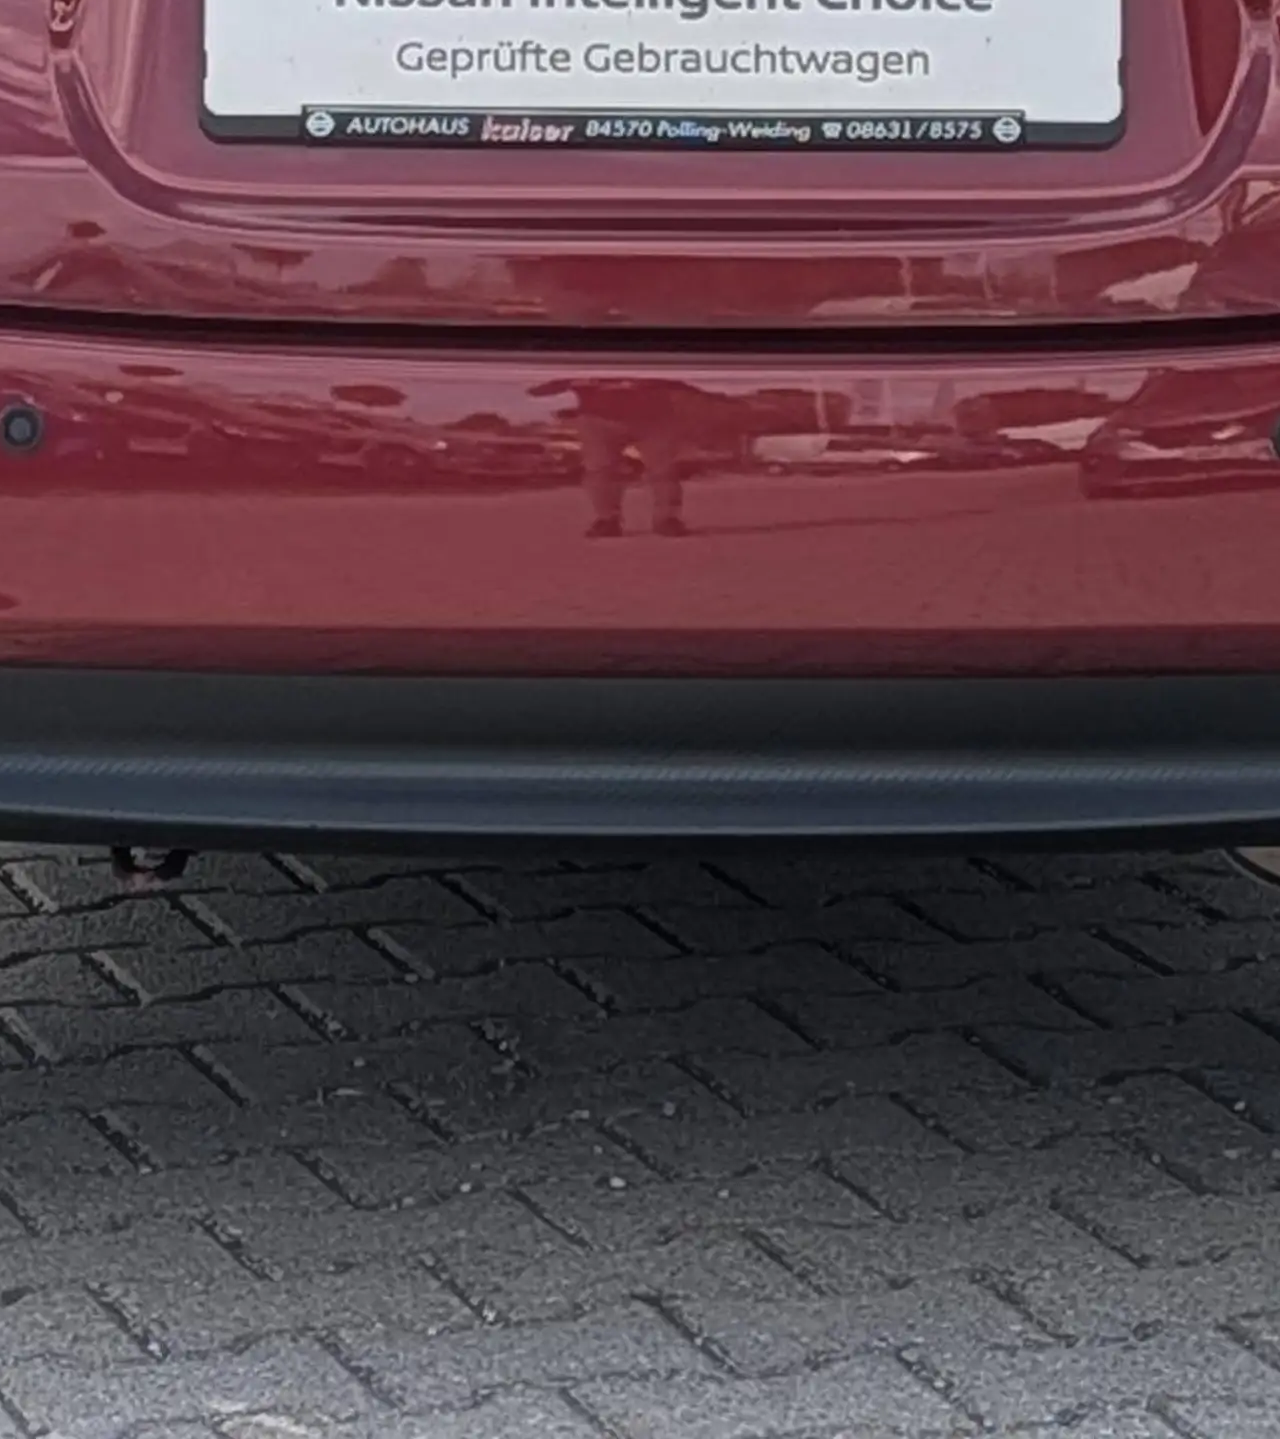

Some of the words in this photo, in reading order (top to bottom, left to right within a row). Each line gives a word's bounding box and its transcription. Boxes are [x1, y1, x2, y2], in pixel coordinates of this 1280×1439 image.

[397, 41, 571, 78] Geprüfte
[584, 42, 930, 82] Gebrauchtwagen
[346, 117, 469, 136] AUTOHAUS
[586, 120, 652, 137] 84570
[846, 120, 982, 140] 08631/8575
